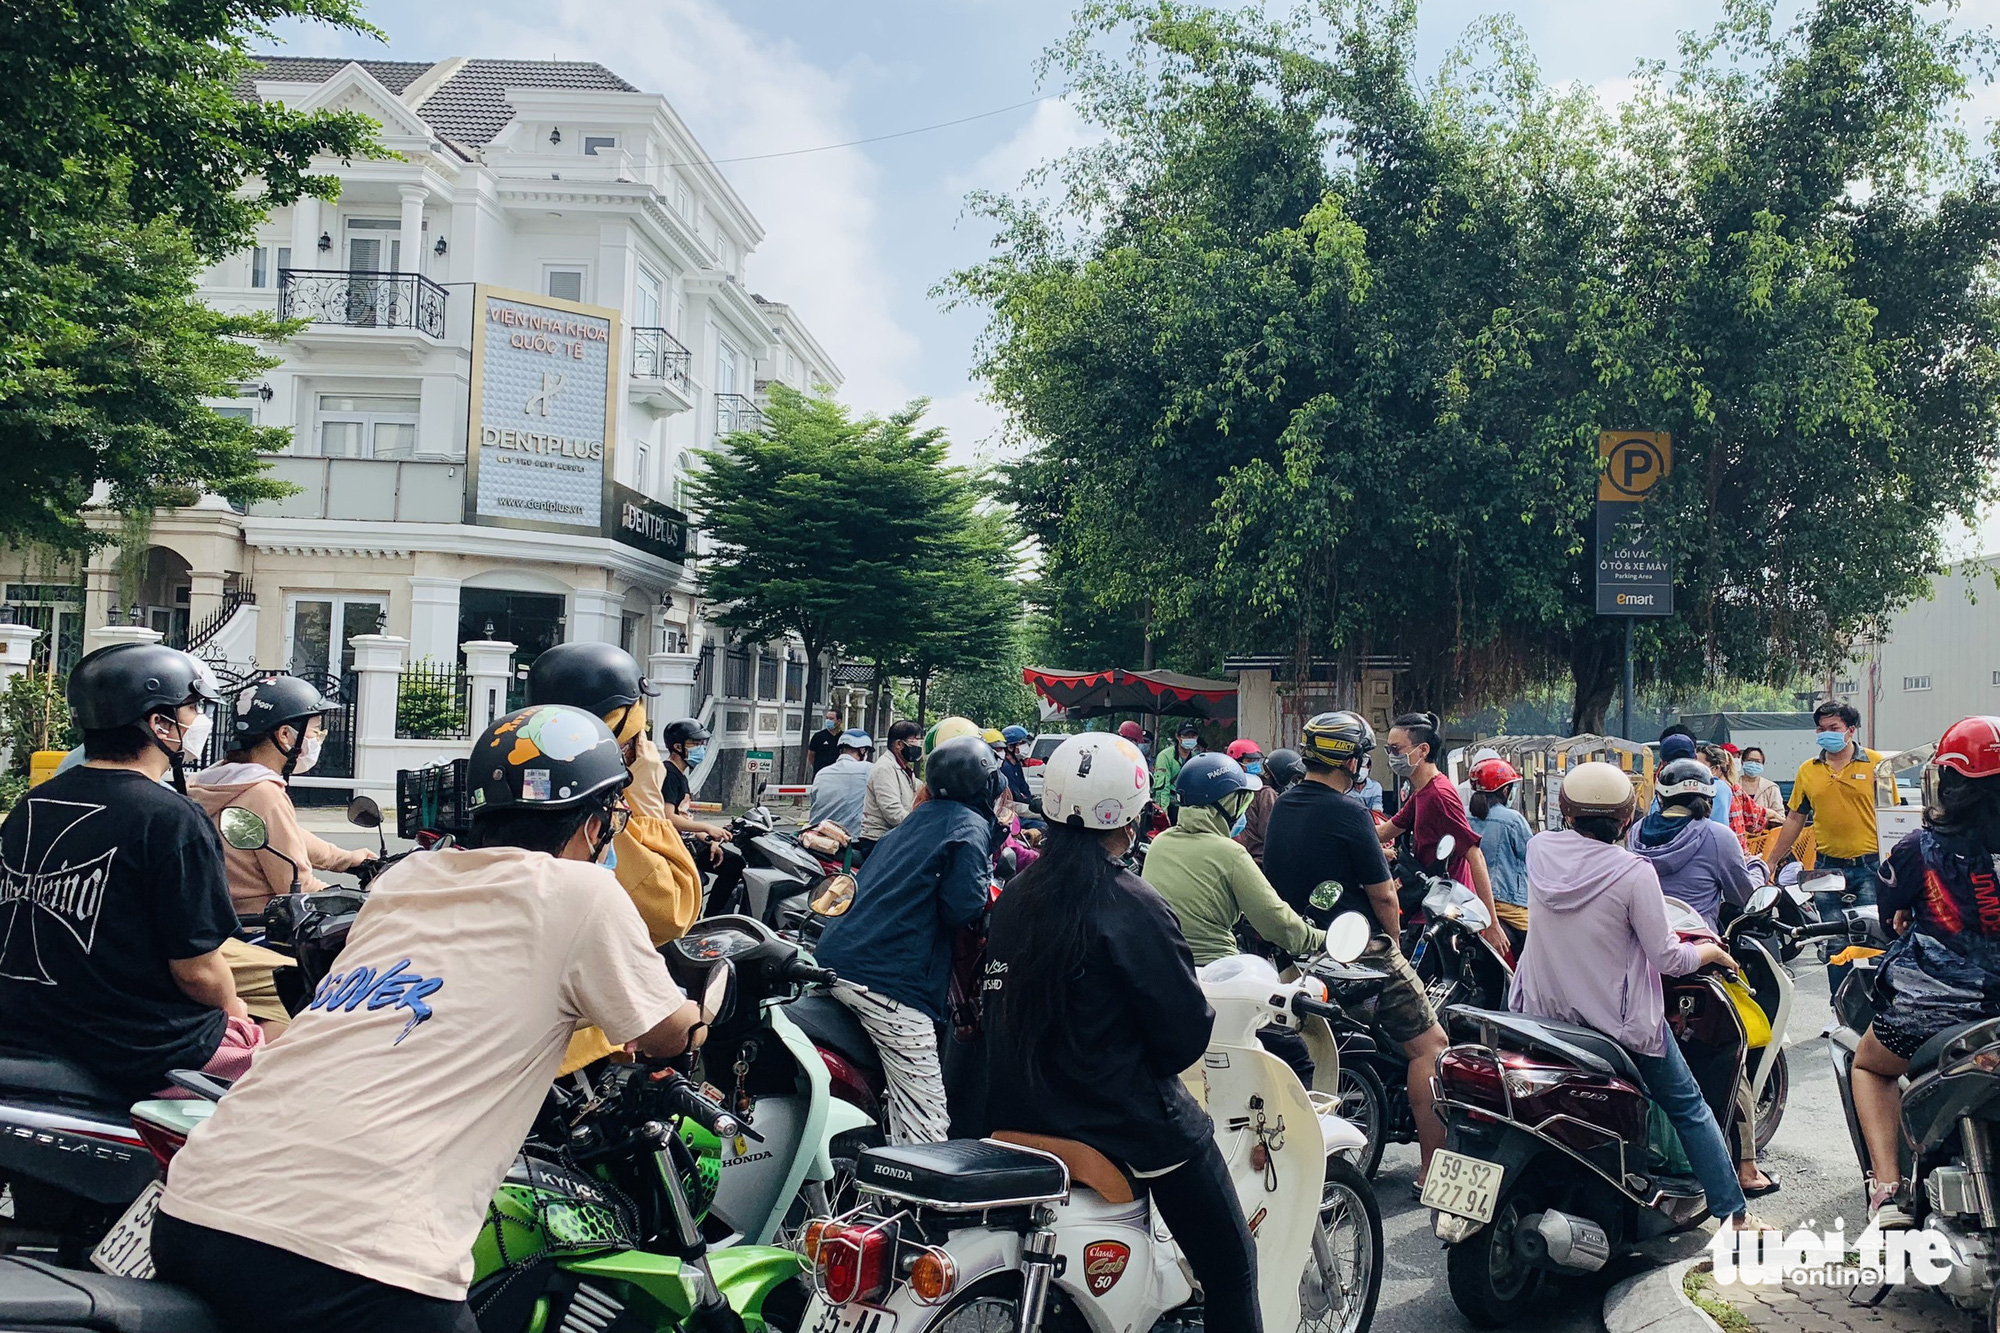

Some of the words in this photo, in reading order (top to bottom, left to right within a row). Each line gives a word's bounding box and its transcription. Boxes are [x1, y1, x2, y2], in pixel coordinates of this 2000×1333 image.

[490, 307, 525, 327] VIỆN
[529, 316, 562, 333] NHA
[565, 321, 607, 342] KHOA
[511, 332, 558, 354] QUỐC
[481, 426, 603, 461] DENTPLUS
[1623, 450, 1653, 487] P
[627, 504, 679, 547] DENTPLUS
[1614, 548, 1630, 559] LỐI
[1600, 560, 1608, 570] Ô
[1609, 560, 1623, 570] TÔ
[1624, 562, 1631, 570] &
[1633, 562, 1644, 570] XE
[1646, 561, 1668, 571] MÁY
[1616, 593, 1654, 605] emart
[253, 699, 274, 711] Piggy
[722, 1150, 773, 1168] HONDA
[873, 1164, 913, 1182] HONDA
[1440, 1155, 1491, 1190] 59-S2
[1425, 1179, 1489, 1217] 227.94
[1089, 1246, 1116, 1258] Classic
[1087, 1255, 1126, 1275] Cub
[1094, 1275, 1112, 1288] 50
